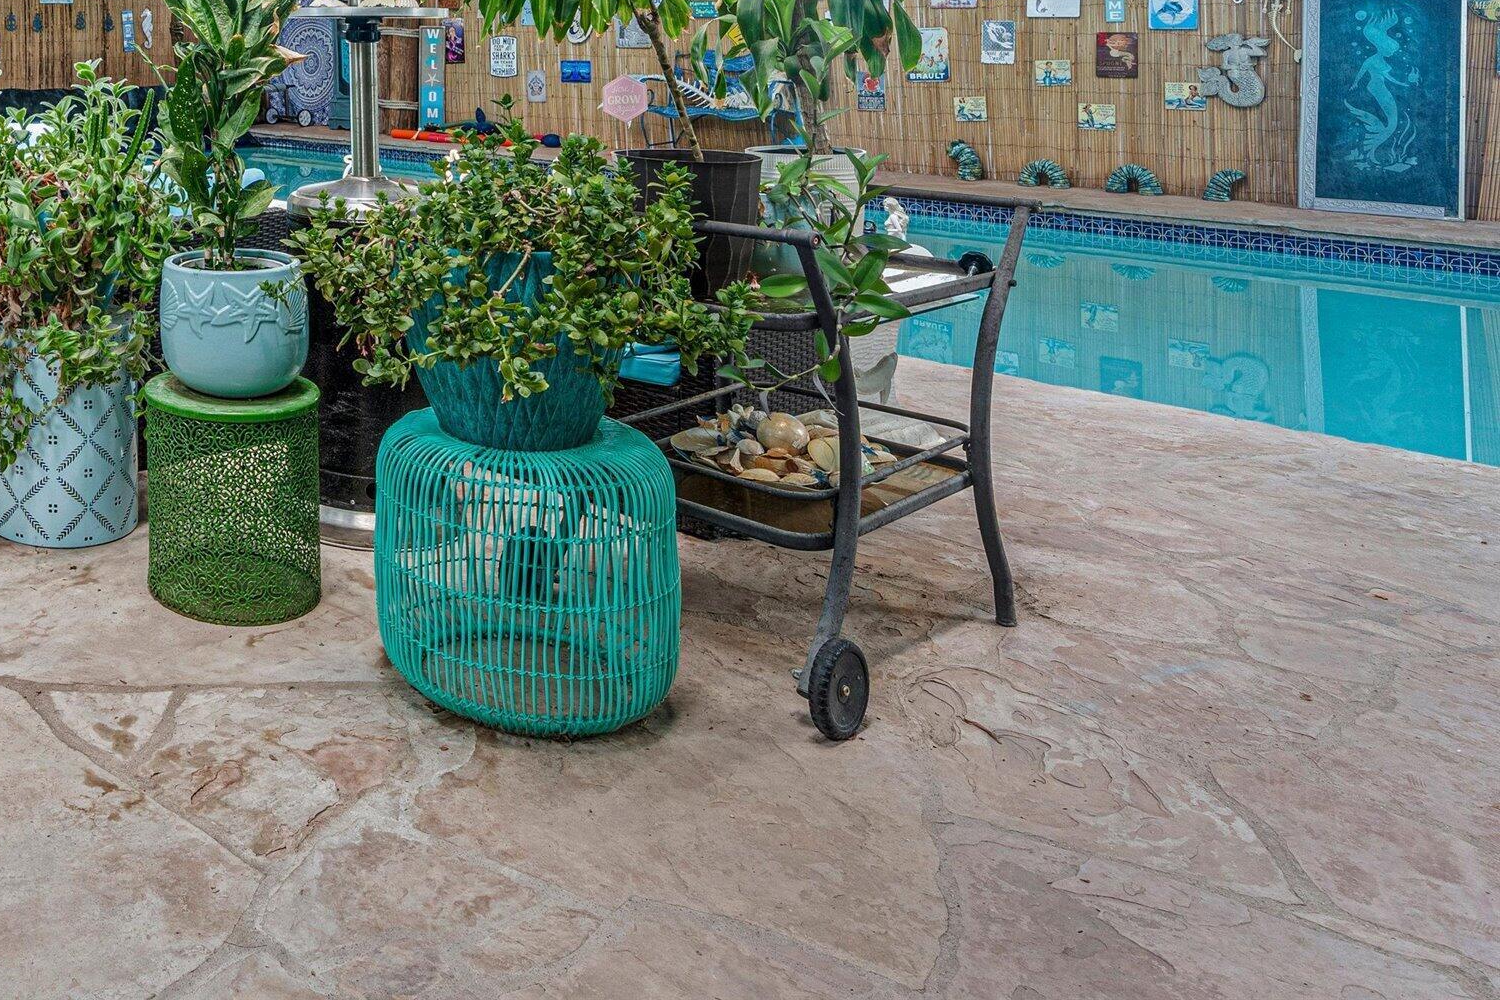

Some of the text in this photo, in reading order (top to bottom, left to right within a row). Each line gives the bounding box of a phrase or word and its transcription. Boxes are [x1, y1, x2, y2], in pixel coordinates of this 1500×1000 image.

[503, 37, 515, 45] NOT
[491, 52, 516, 60] SHARKS
[607, 94, 640, 105] GROW
